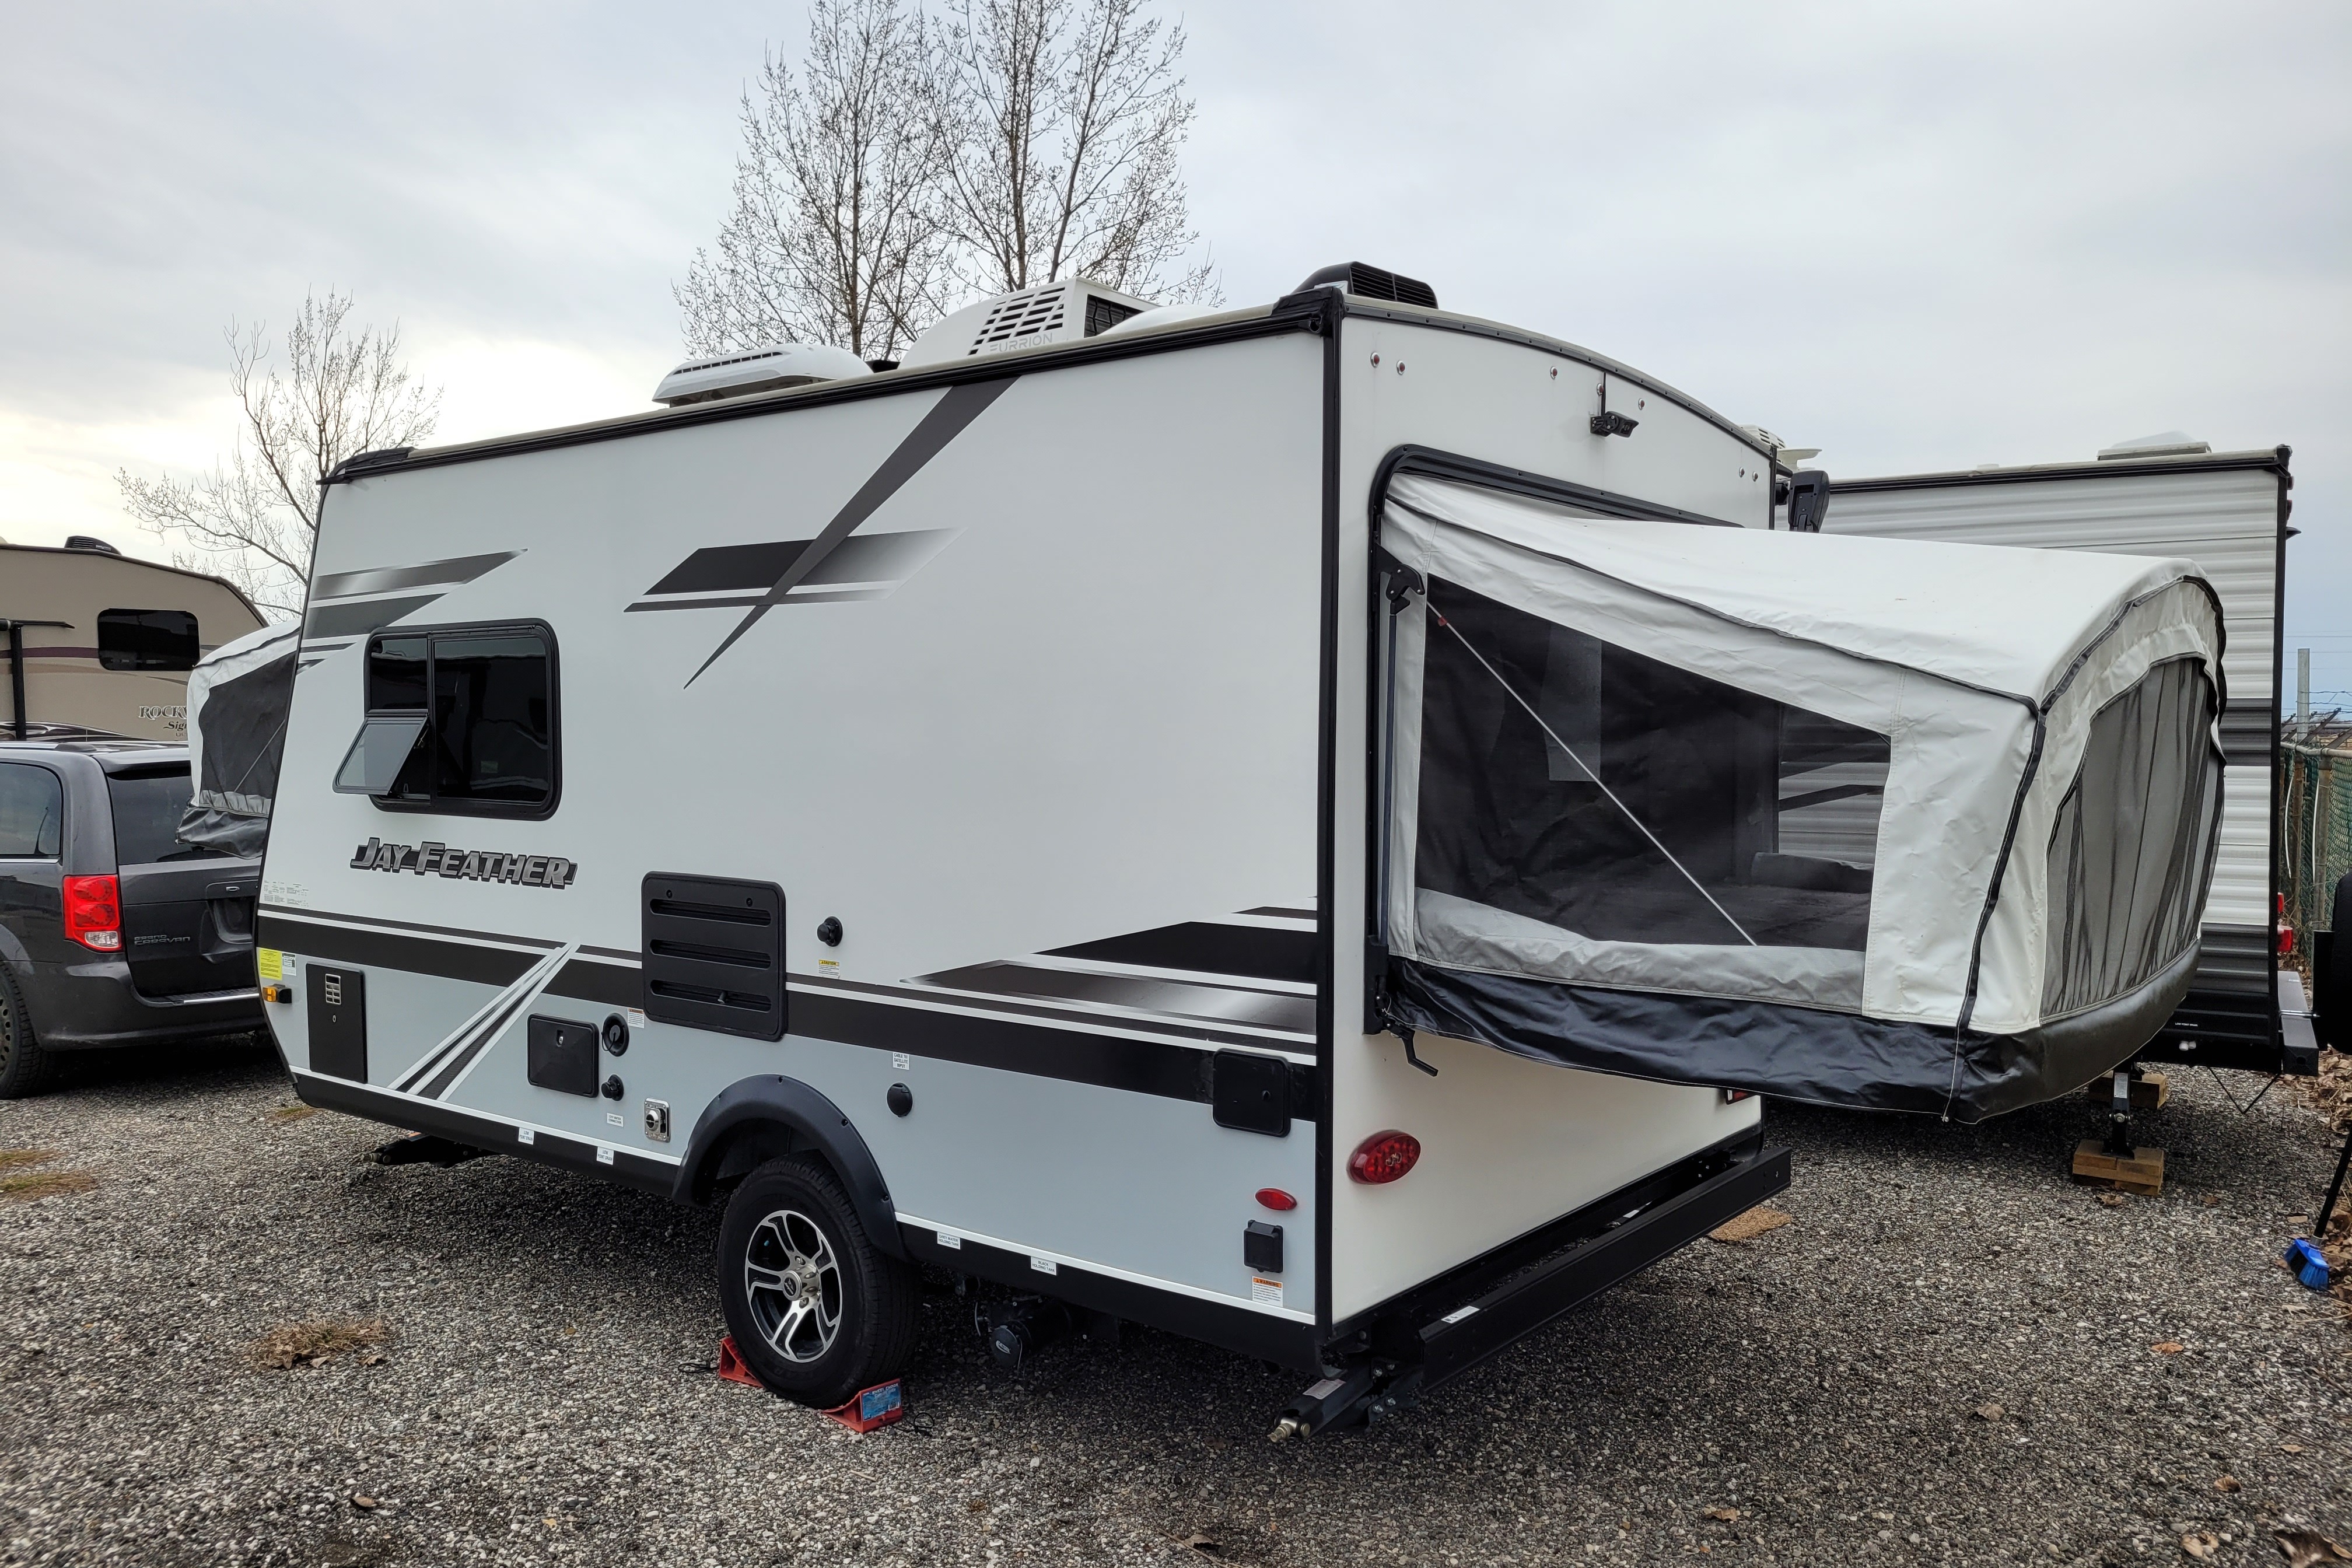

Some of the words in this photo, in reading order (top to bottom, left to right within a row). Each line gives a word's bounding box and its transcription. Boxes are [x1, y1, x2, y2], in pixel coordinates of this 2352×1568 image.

[990, 332, 1052, 352] FURRION
[350, 836, 412, 873] JAY
[414, 841, 572, 890] FEATHER
